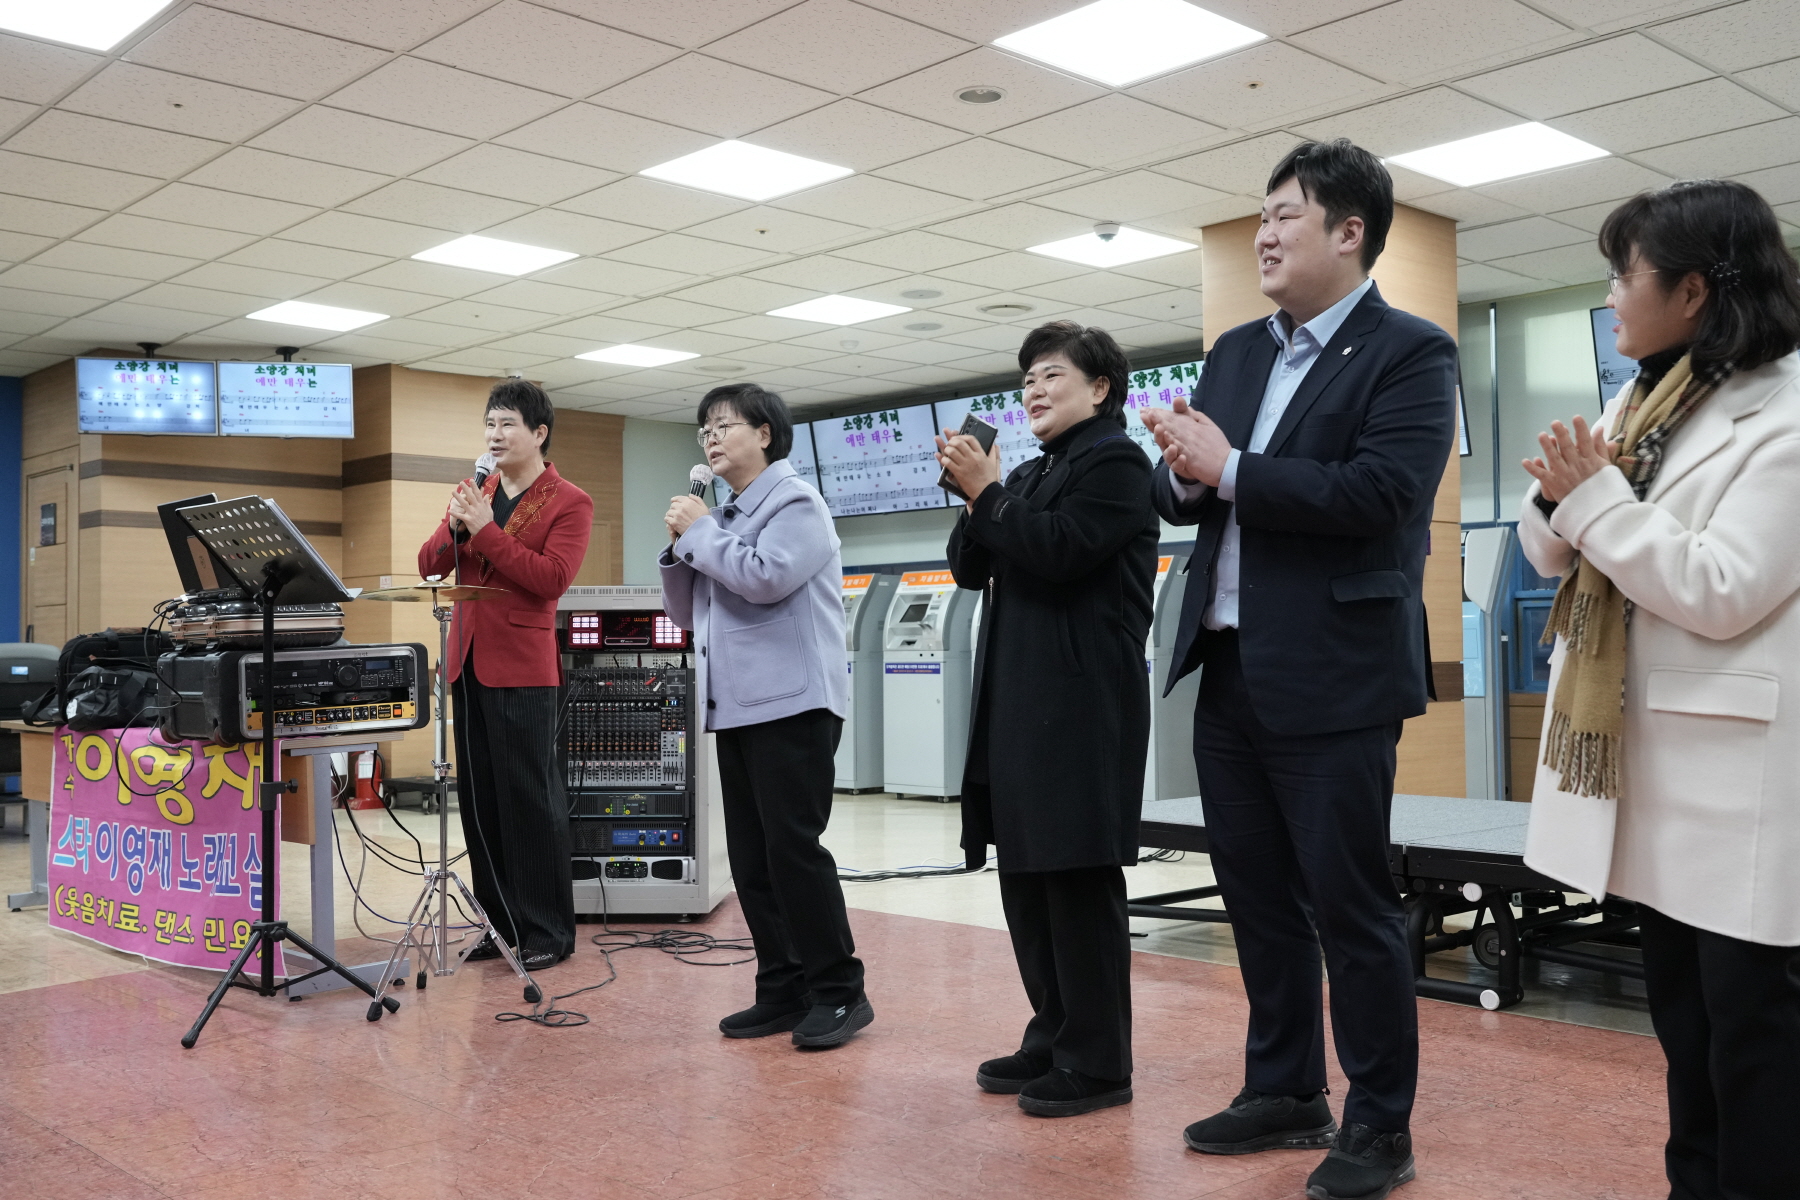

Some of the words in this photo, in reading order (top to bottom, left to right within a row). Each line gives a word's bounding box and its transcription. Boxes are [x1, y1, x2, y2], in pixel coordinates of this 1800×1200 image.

[114, 361, 151, 373] 소양강
[156, 361, 179, 373] 처녀
[254, 365, 289, 376] 소양강
[294, 365, 317, 377] 처녀
[1169, 363, 1199, 384] 처녀
[969, 393, 1007, 412] 소양강
[1012, 390, 1025, 406] 처
[842, 413, 875, 431] 소양강
[878, 409, 900, 427] 처녀
[1003, 409, 1027, 426] 태우
[845, 432, 866, 448] 애만
[871, 428, 903, 446] 태우는
[52, 814, 93, 875] 스타
[95, 821, 172, 897] 이영재
[55, 883, 149, 934] (웃음치료.
